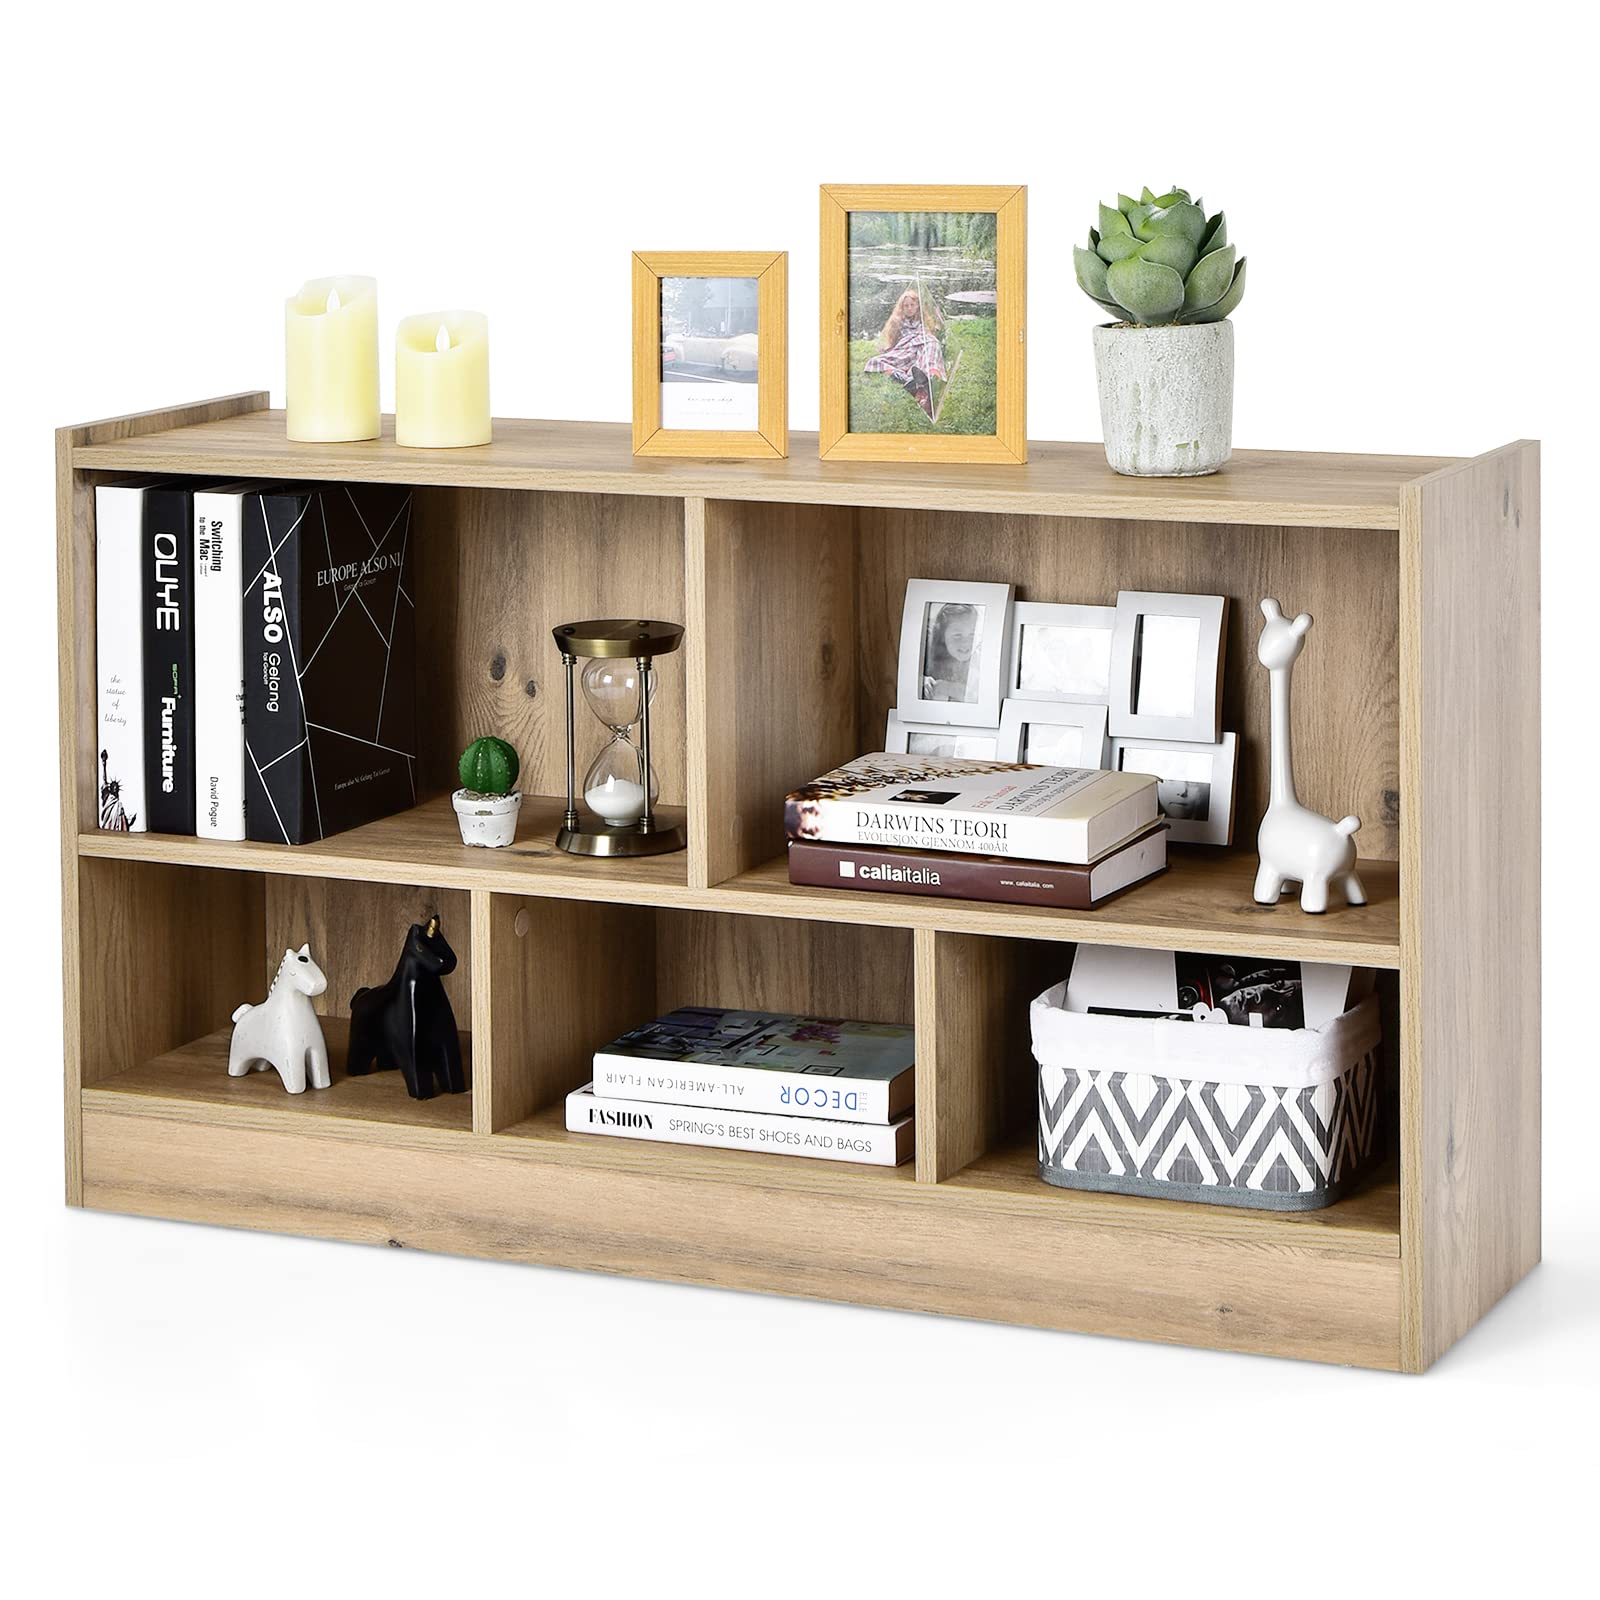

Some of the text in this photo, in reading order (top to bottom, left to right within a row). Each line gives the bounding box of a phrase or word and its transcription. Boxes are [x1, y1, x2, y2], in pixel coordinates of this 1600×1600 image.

[199, 538, 210, 561] Mac
[210, 520, 223, 572] Switching
[317, 561, 358, 587] EUROPE
[360, 555, 388, 576] ALSO
[263, 570, 283, 713] ALSO Gelang
[111, 698, 120, 711] of
[161, 696, 178, 794] Furniture
[208, 776, 219, 827] David Pogue
[995, 783, 1050, 811] DARWINS
[856, 811, 1008, 839] DARWINS TEORI
[858, 831, 919, 846] EVOLUSJON
[921, 836, 975, 849] GJENNOM
[859, 863, 941, 886] caliaitalia
[606, 1072, 745, 1096] ALL-AMERICAN FLAIR
[780, 1085, 857, 1111] DECOR
[589, 1108, 653, 1130] FASHION
[669, 1118, 872, 1153] SPRING'S BEST SHOES AND BAGS
